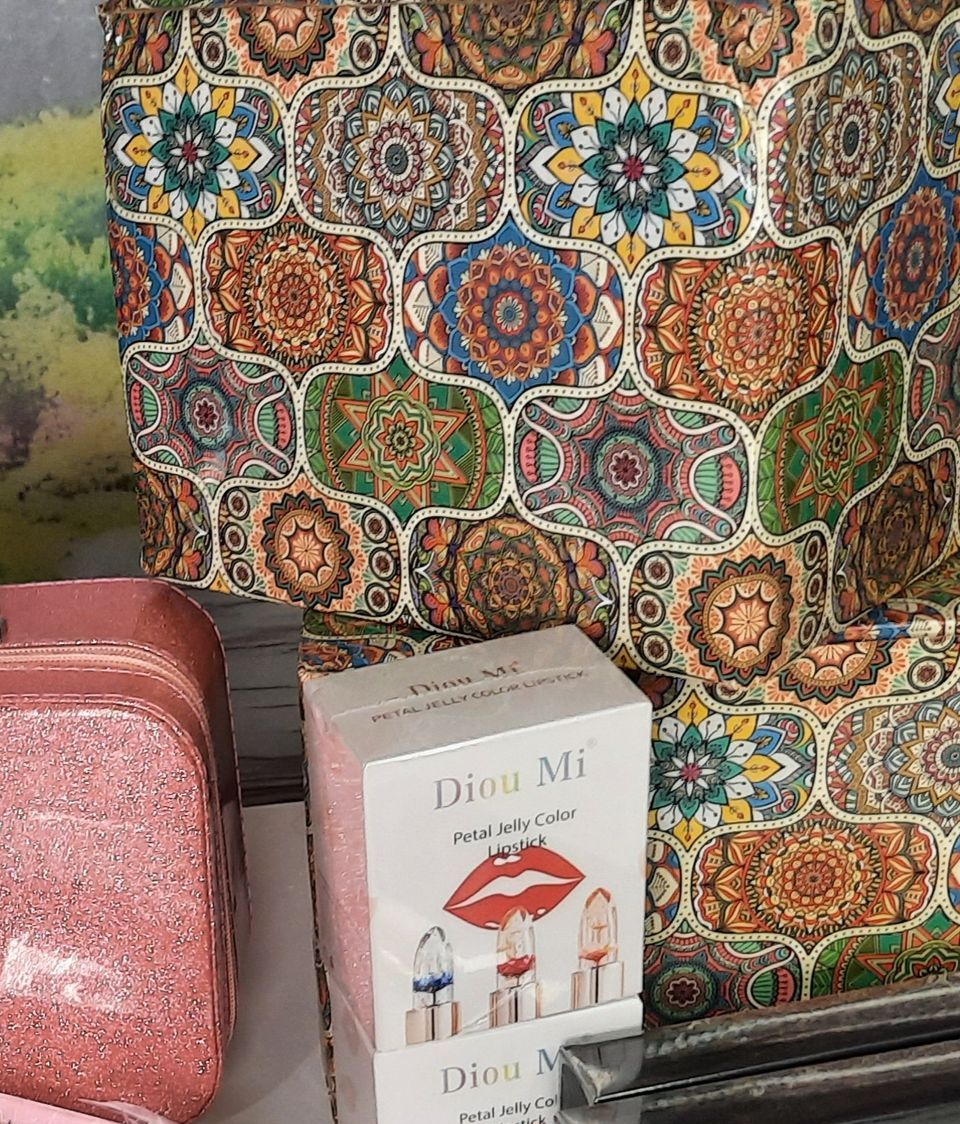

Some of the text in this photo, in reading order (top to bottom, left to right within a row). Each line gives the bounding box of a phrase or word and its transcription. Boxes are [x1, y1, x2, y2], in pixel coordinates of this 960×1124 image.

[371, 706, 422, 723] PETAL
[426, 694, 468, 710] JELLY
[433, 748, 587, 810] Diou Mi
[453, 808, 577, 845] Petal Jelly Color
[488, 833, 547, 860] Lipstick
[440, 1061, 521, 1095] Diou
[459, 1106, 495, 1124] Petal
[499, 1101, 532, 1118] Jelly
